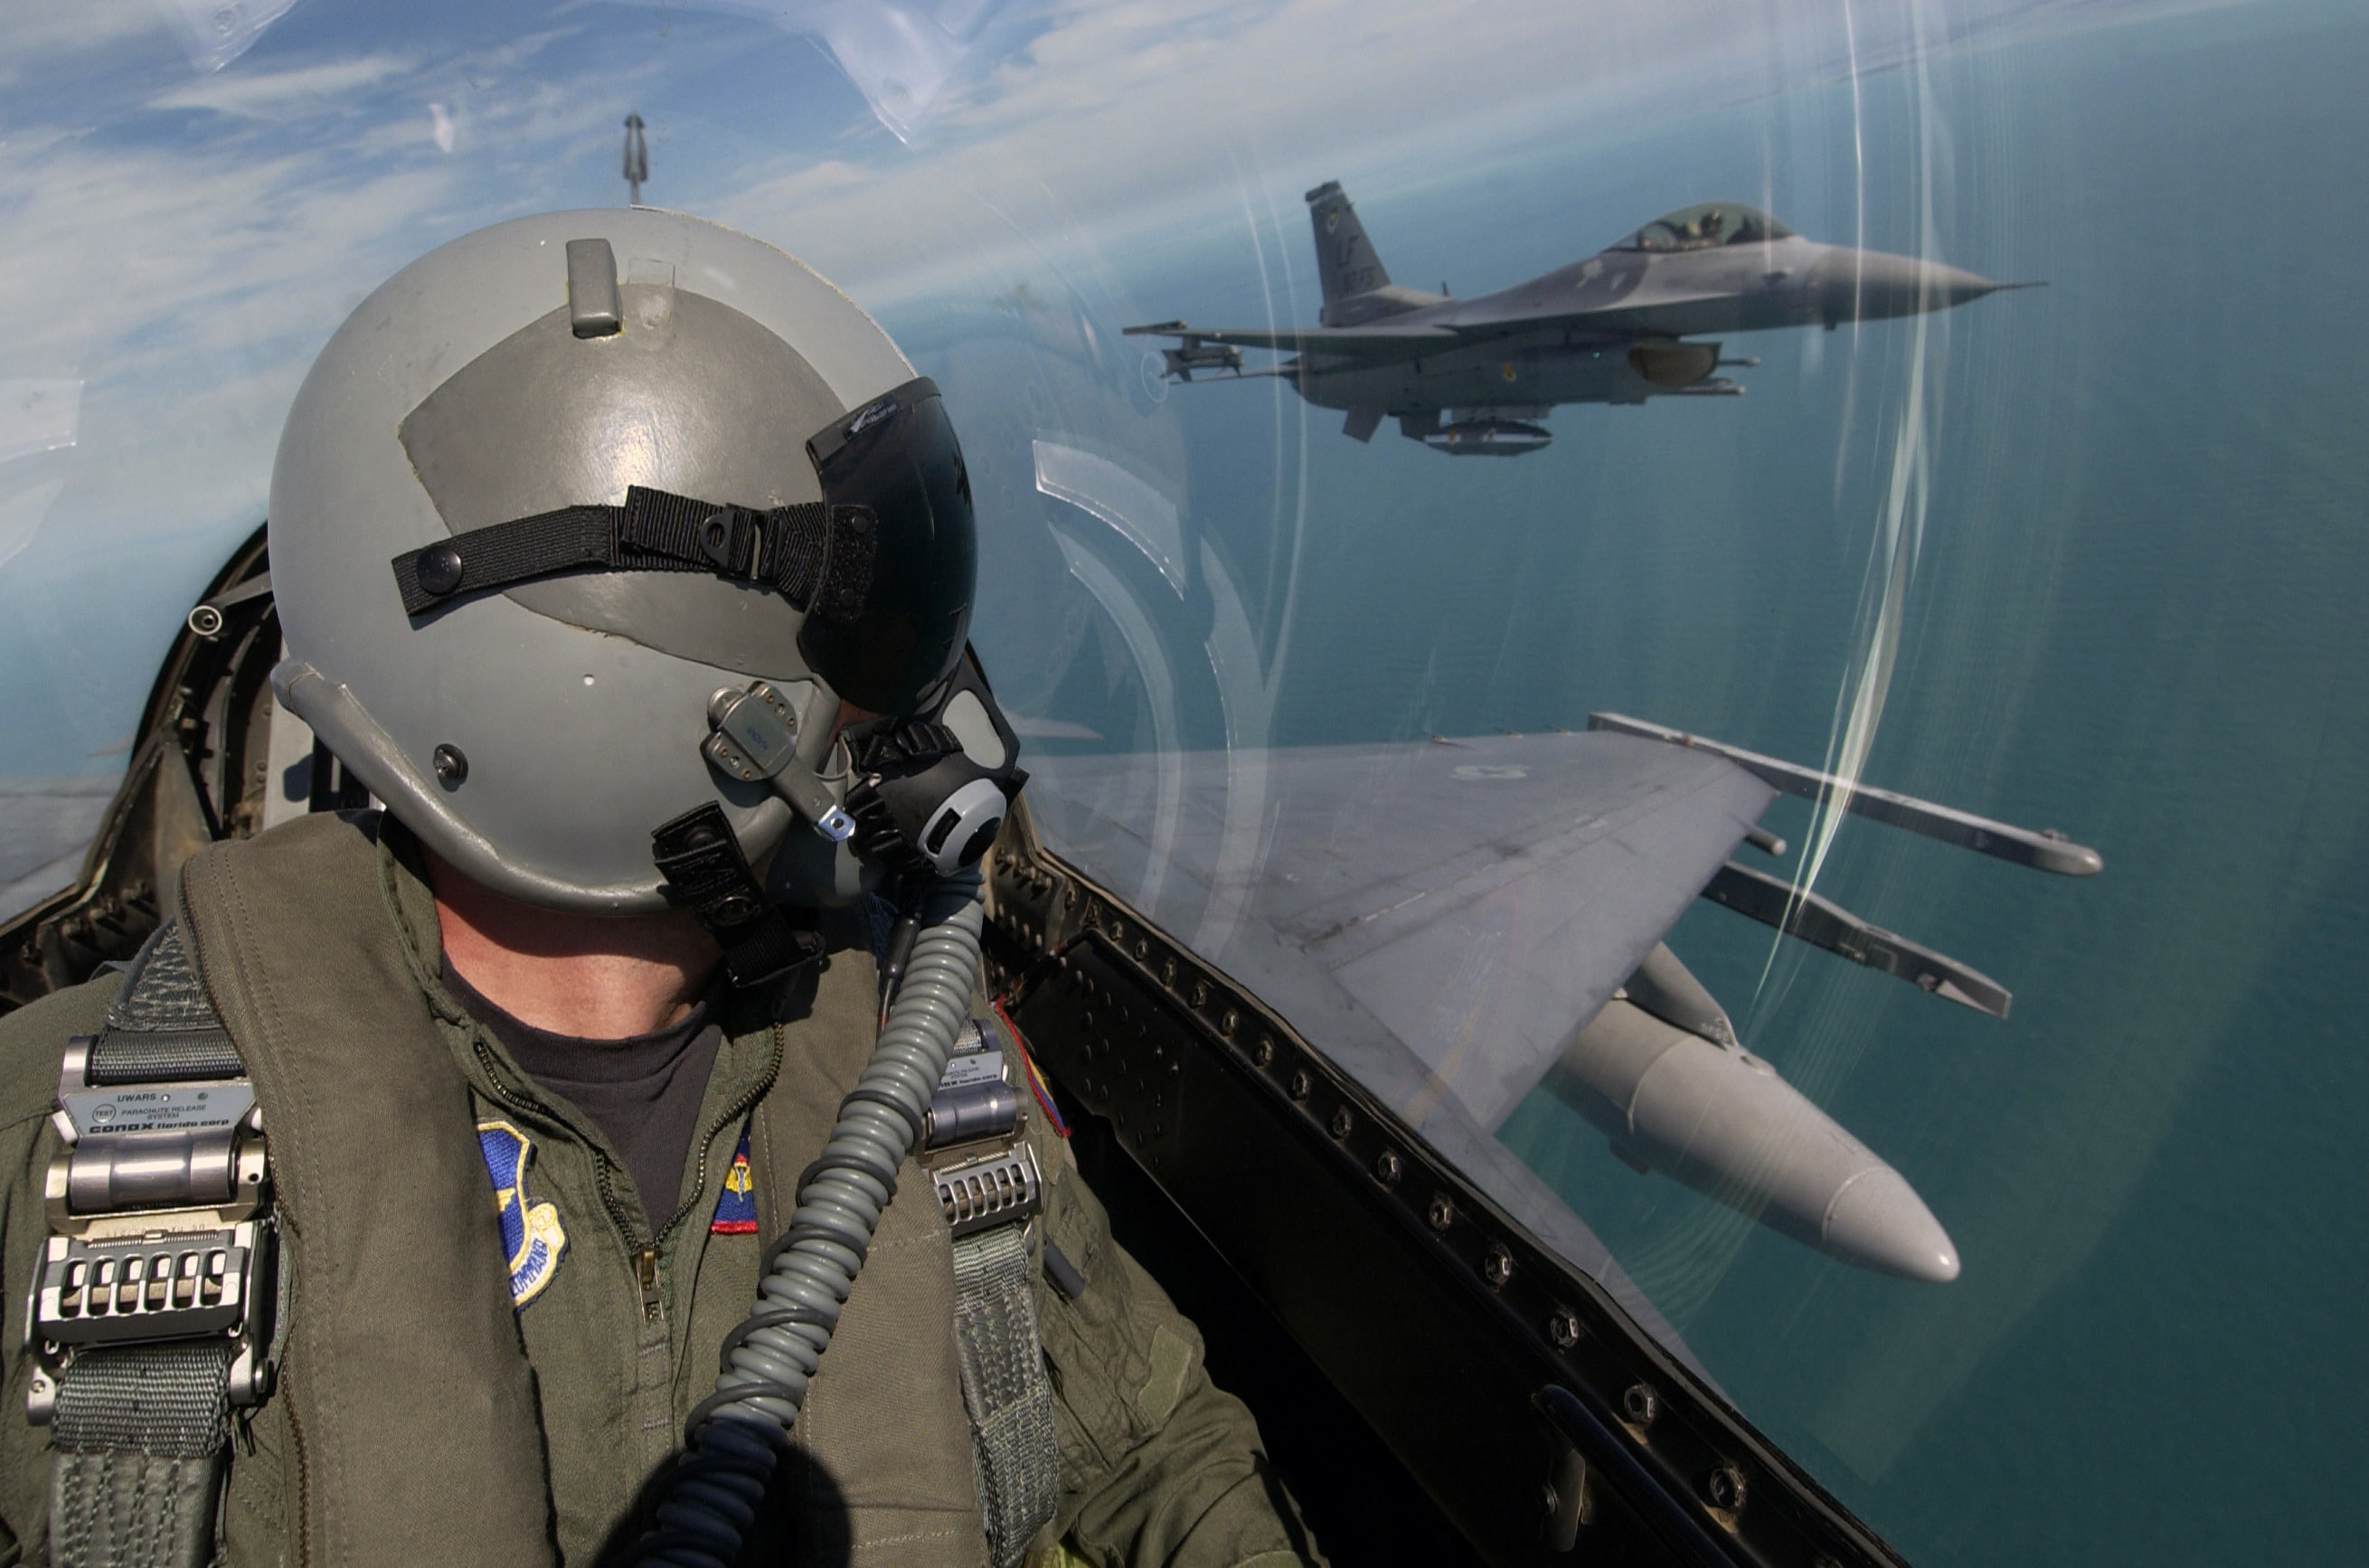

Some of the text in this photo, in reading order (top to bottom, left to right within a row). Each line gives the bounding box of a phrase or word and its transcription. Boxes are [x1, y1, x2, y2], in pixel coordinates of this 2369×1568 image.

[118, 1093, 156, 1102] UWARS
[121, 1104, 207, 1116] PARACHUTE RELEASE
[147, 1112, 179, 1120] SYSTEM
[201, 1119, 230, 1127] corp
